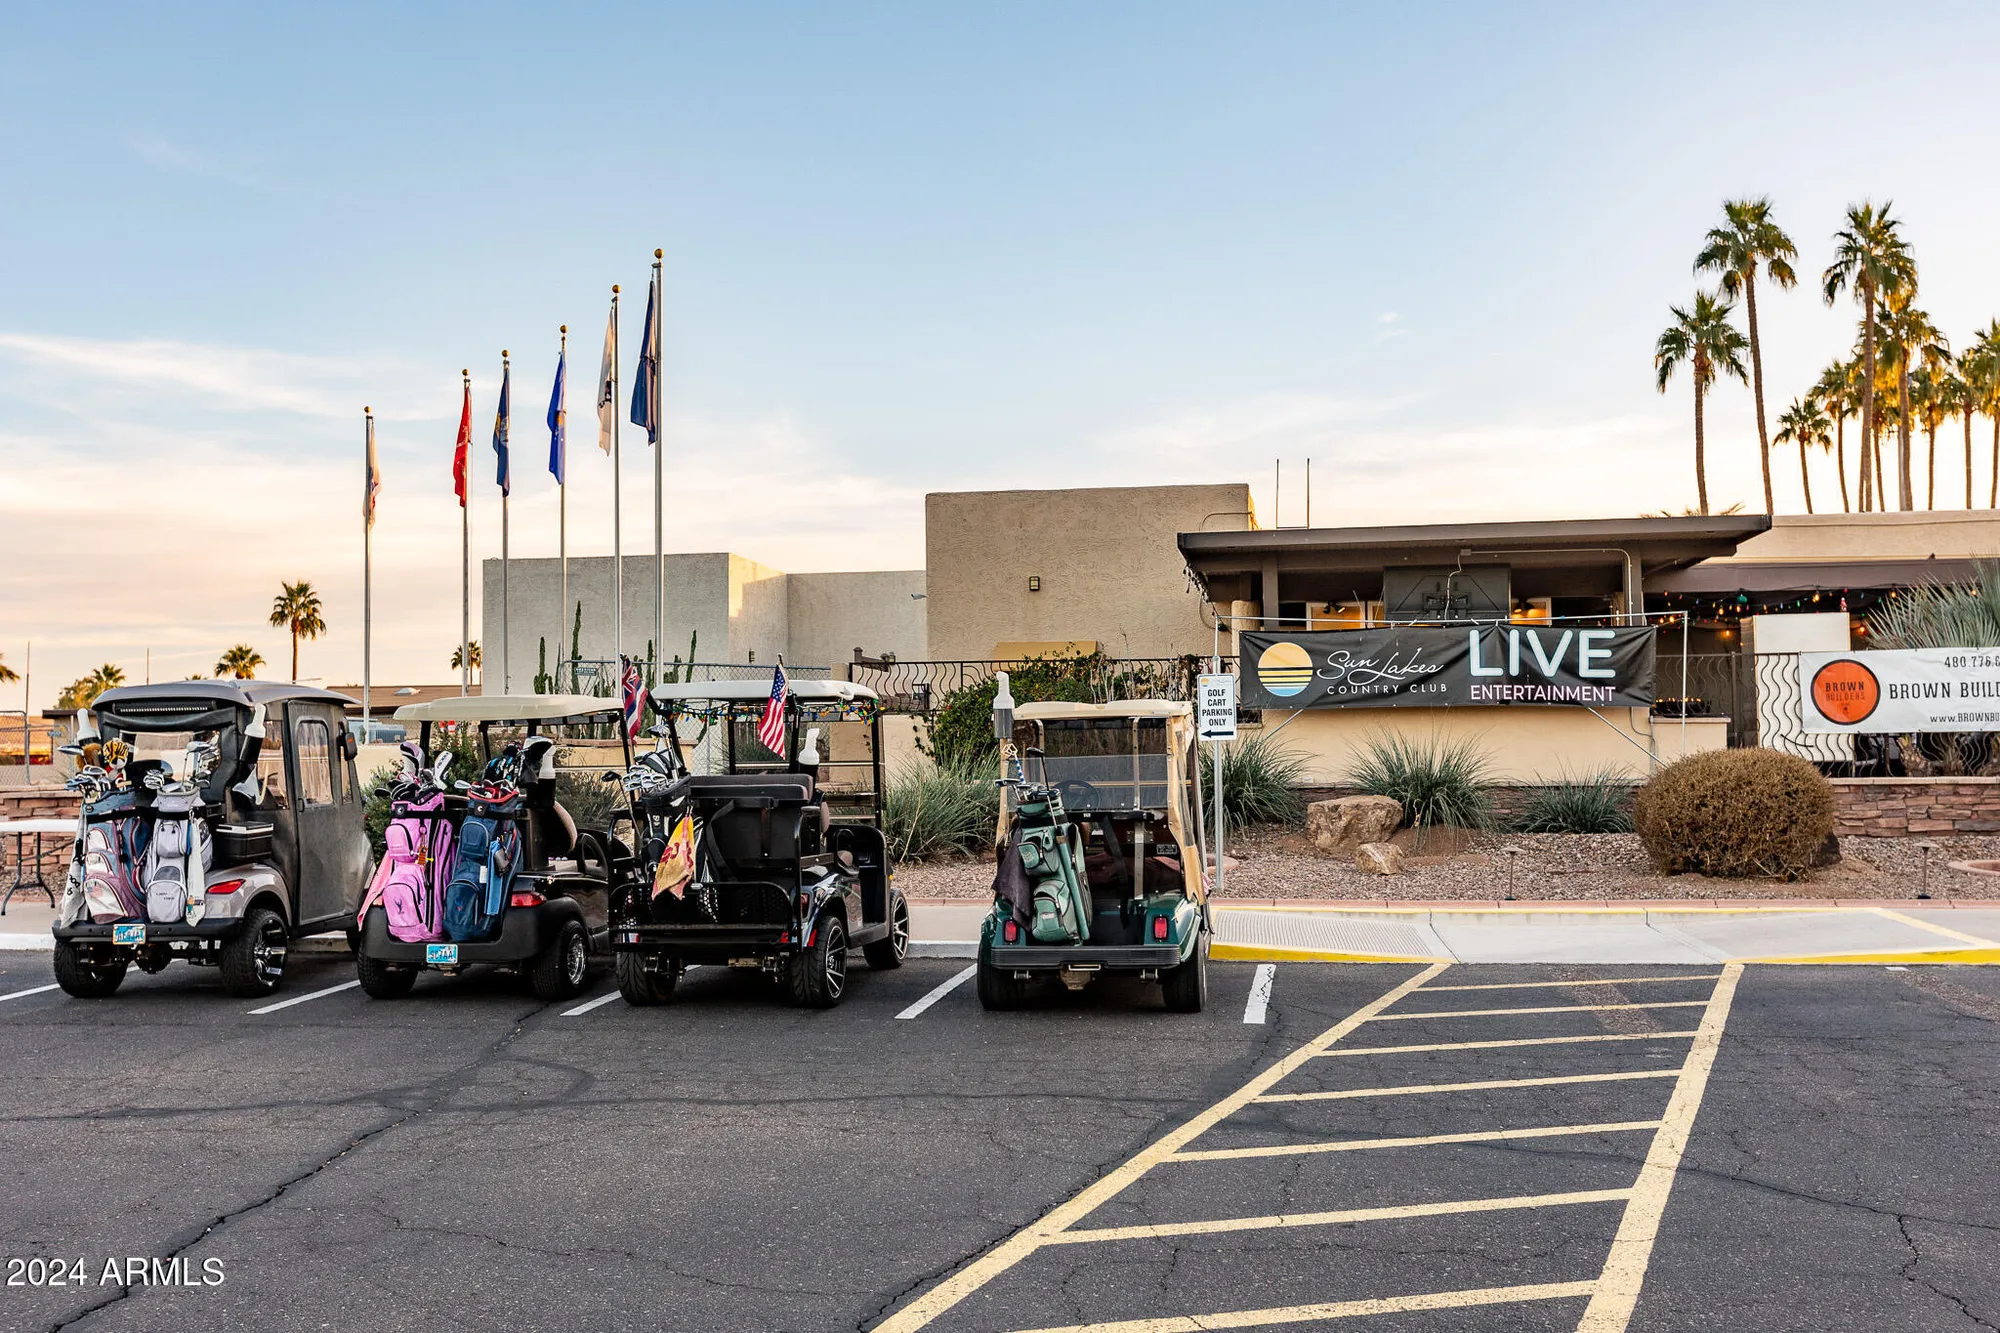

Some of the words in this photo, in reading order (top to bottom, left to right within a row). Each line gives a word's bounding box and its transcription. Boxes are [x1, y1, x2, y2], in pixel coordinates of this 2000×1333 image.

[1469, 629, 1616, 678] LIVE
[1316, 650, 1380, 680] Sun
[1347, 647, 1444, 686] Lakes
[1327, 684, 1399, 695] COUNTRY
[1409, 683, 1448, 693] CLUB
[1826, 681, 1864, 692] BROWN
[1889, 682, 1951, 699] BROWN
[1207, 688, 1226, 697] GOLF
[1470, 685, 1616, 702] ENTERTAINMENT
[1826, 691, 1865, 701] BUILDERS
[1207, 698, 1227, 707] CART
[1202, 708, 1233, 717] PARKING
[1208, 718, 1227, 727] ONLY
